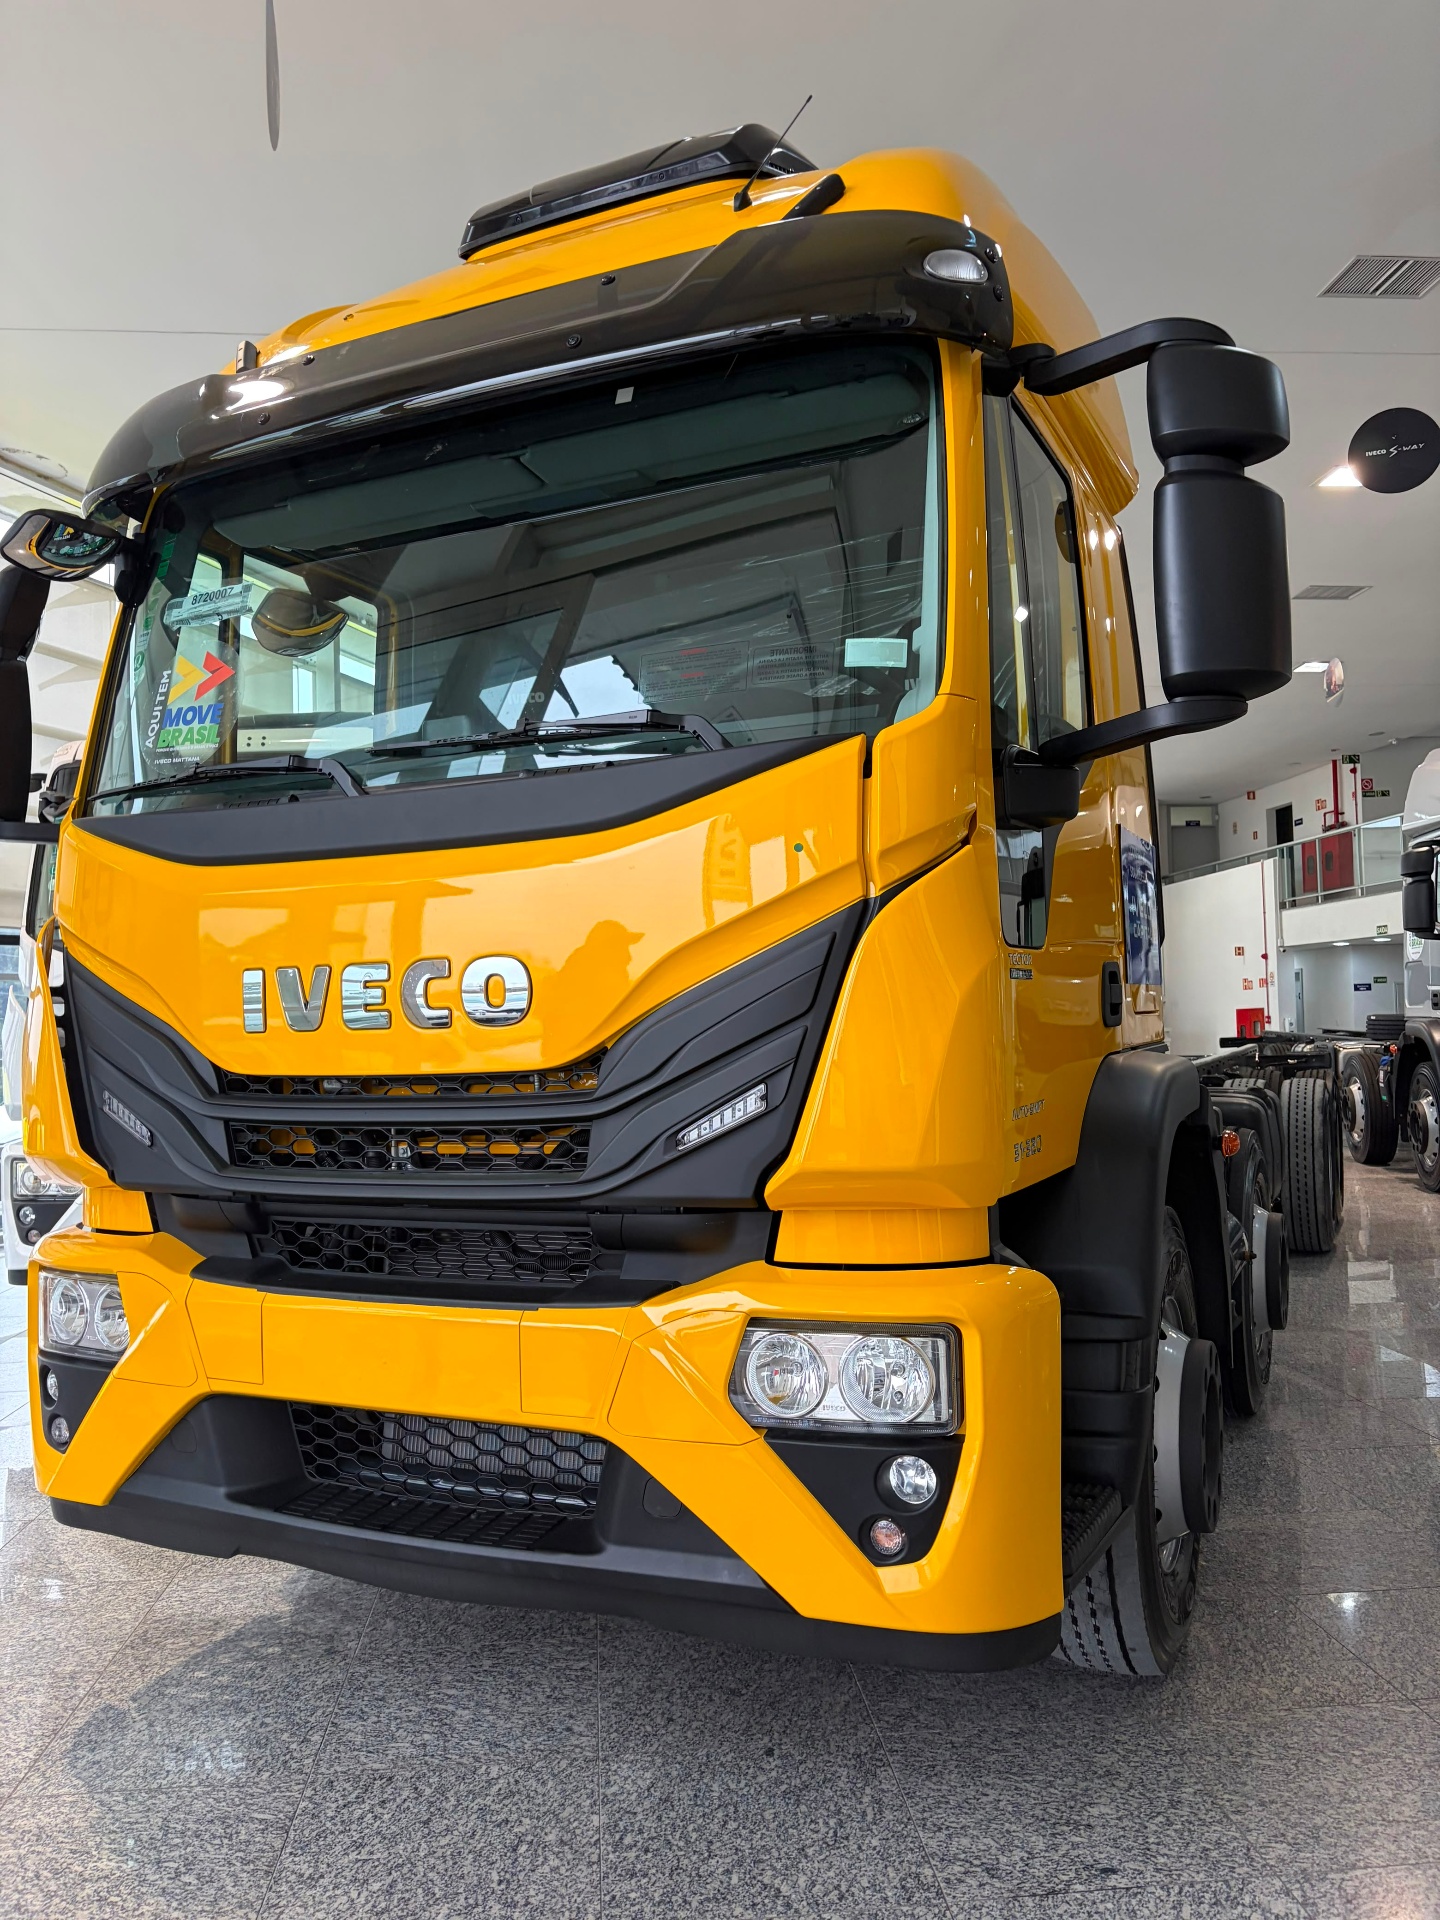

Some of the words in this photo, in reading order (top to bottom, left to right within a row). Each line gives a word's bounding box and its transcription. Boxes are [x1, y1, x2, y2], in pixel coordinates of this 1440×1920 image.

[1366, 449, 1387, 457] IVECO
[1389, 443, 1425, 458] S-WAY
[191, 586, 235, 606] 8720007
[145, 705, 163, 749] AQUI
[155, 669, 172, 705] TEM
[162, 703, 224, 729] MOVE
[157, 724, 221, 748] BRASIL
[1008, 952, 1033, 965] TECTOR
[242, 955, 533, 1033] IVECO
